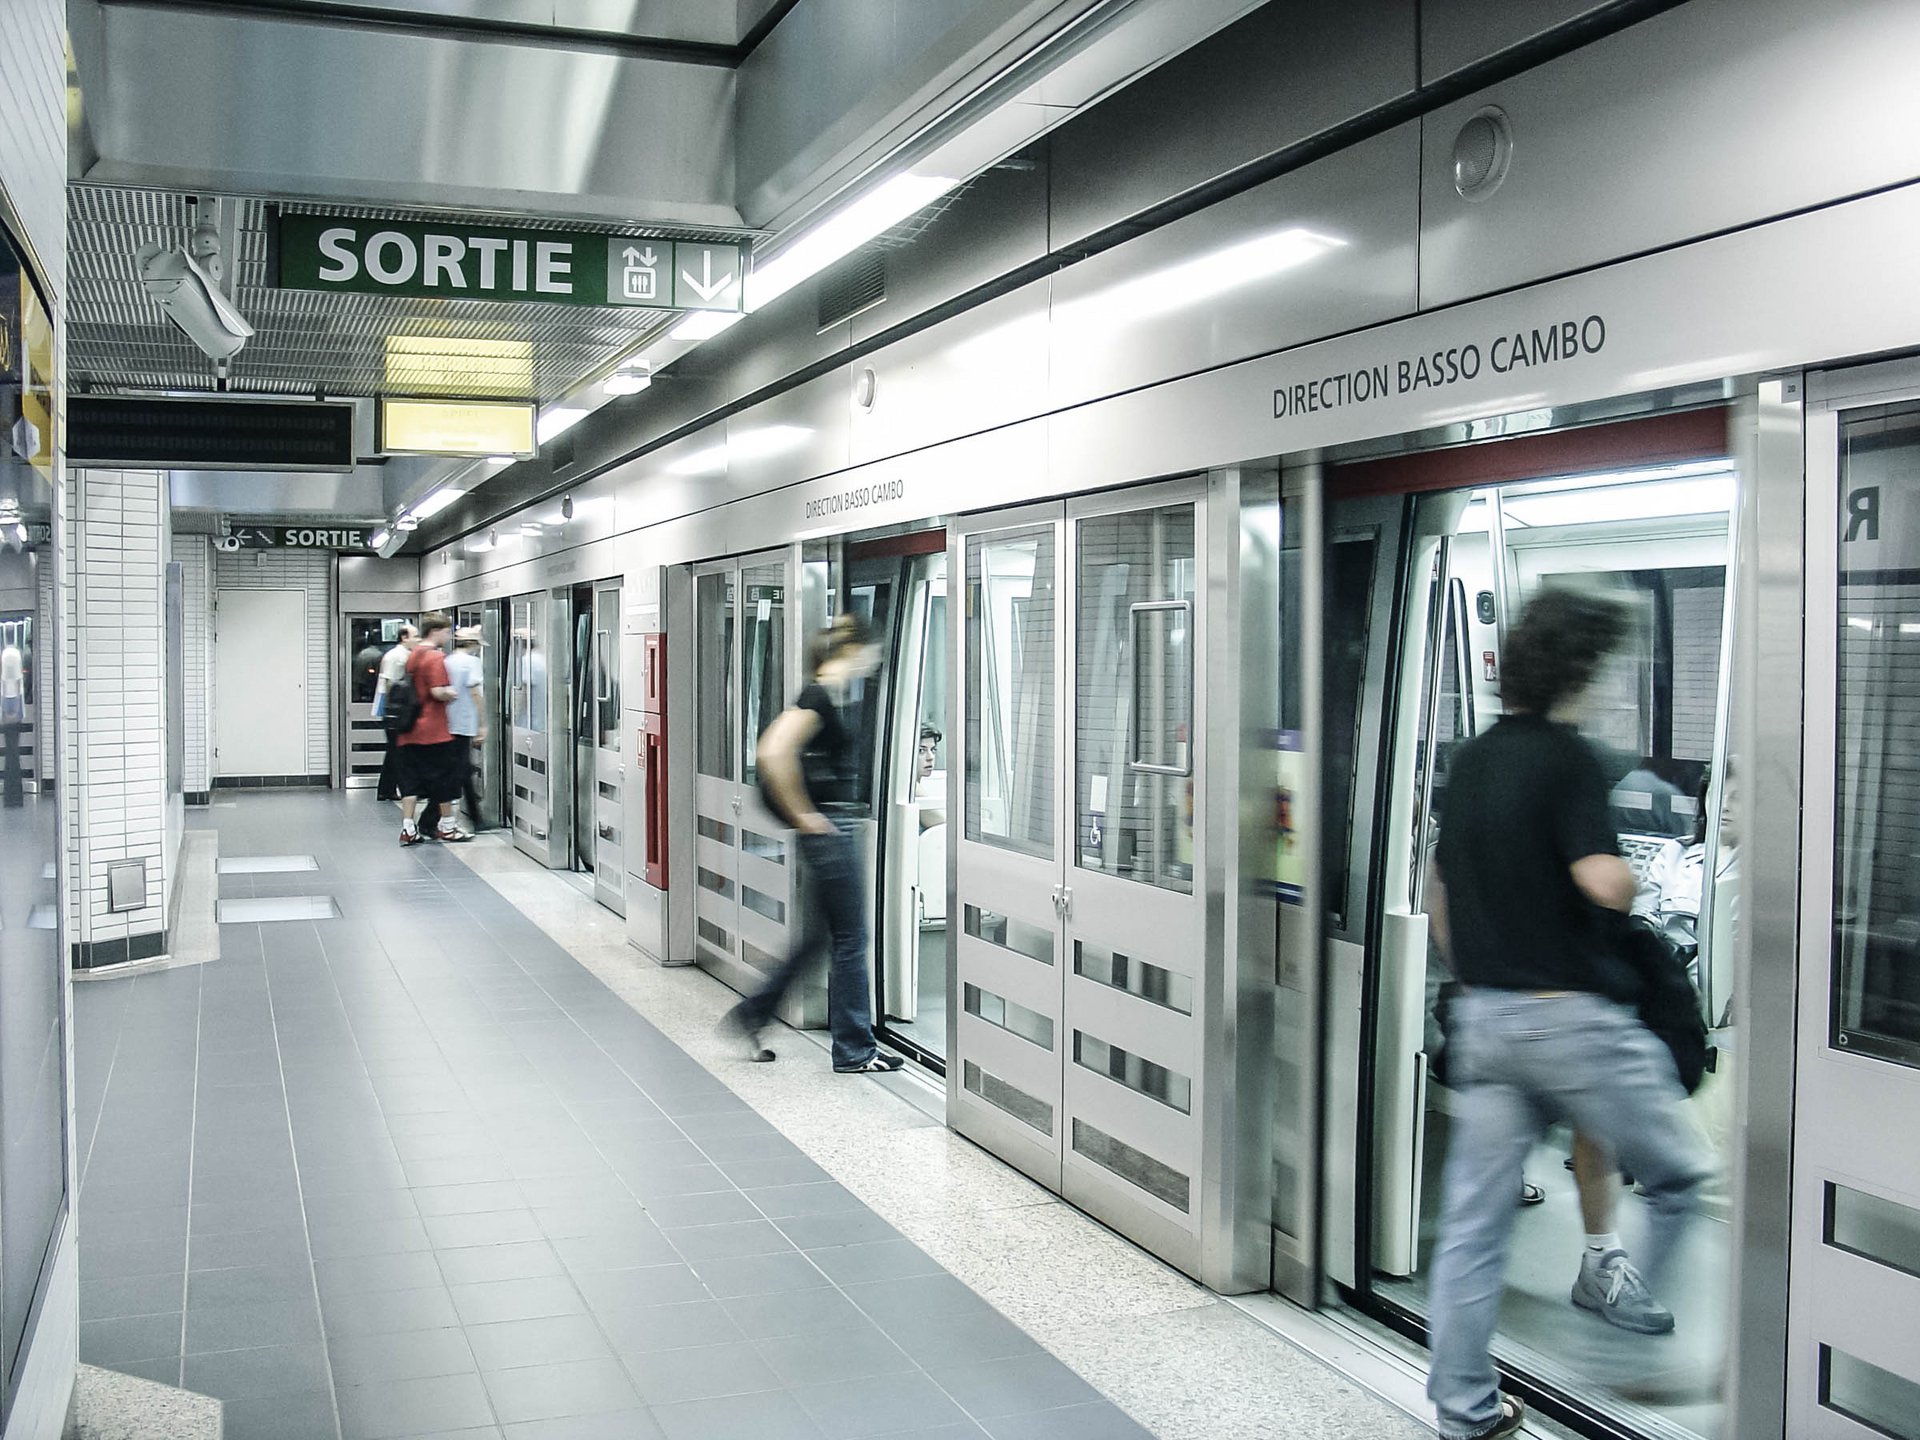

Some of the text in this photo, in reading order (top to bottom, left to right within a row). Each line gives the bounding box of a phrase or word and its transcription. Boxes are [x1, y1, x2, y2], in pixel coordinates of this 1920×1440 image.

[318, 228, 574, 294] SORTIE
[1273, 315, 1607, 420] DIRECTION BASSO CAMBO
[805, 479, 904, 519] DIRECTION BASSO CAMBO
[285, 529, 364, 547] SORTIE
